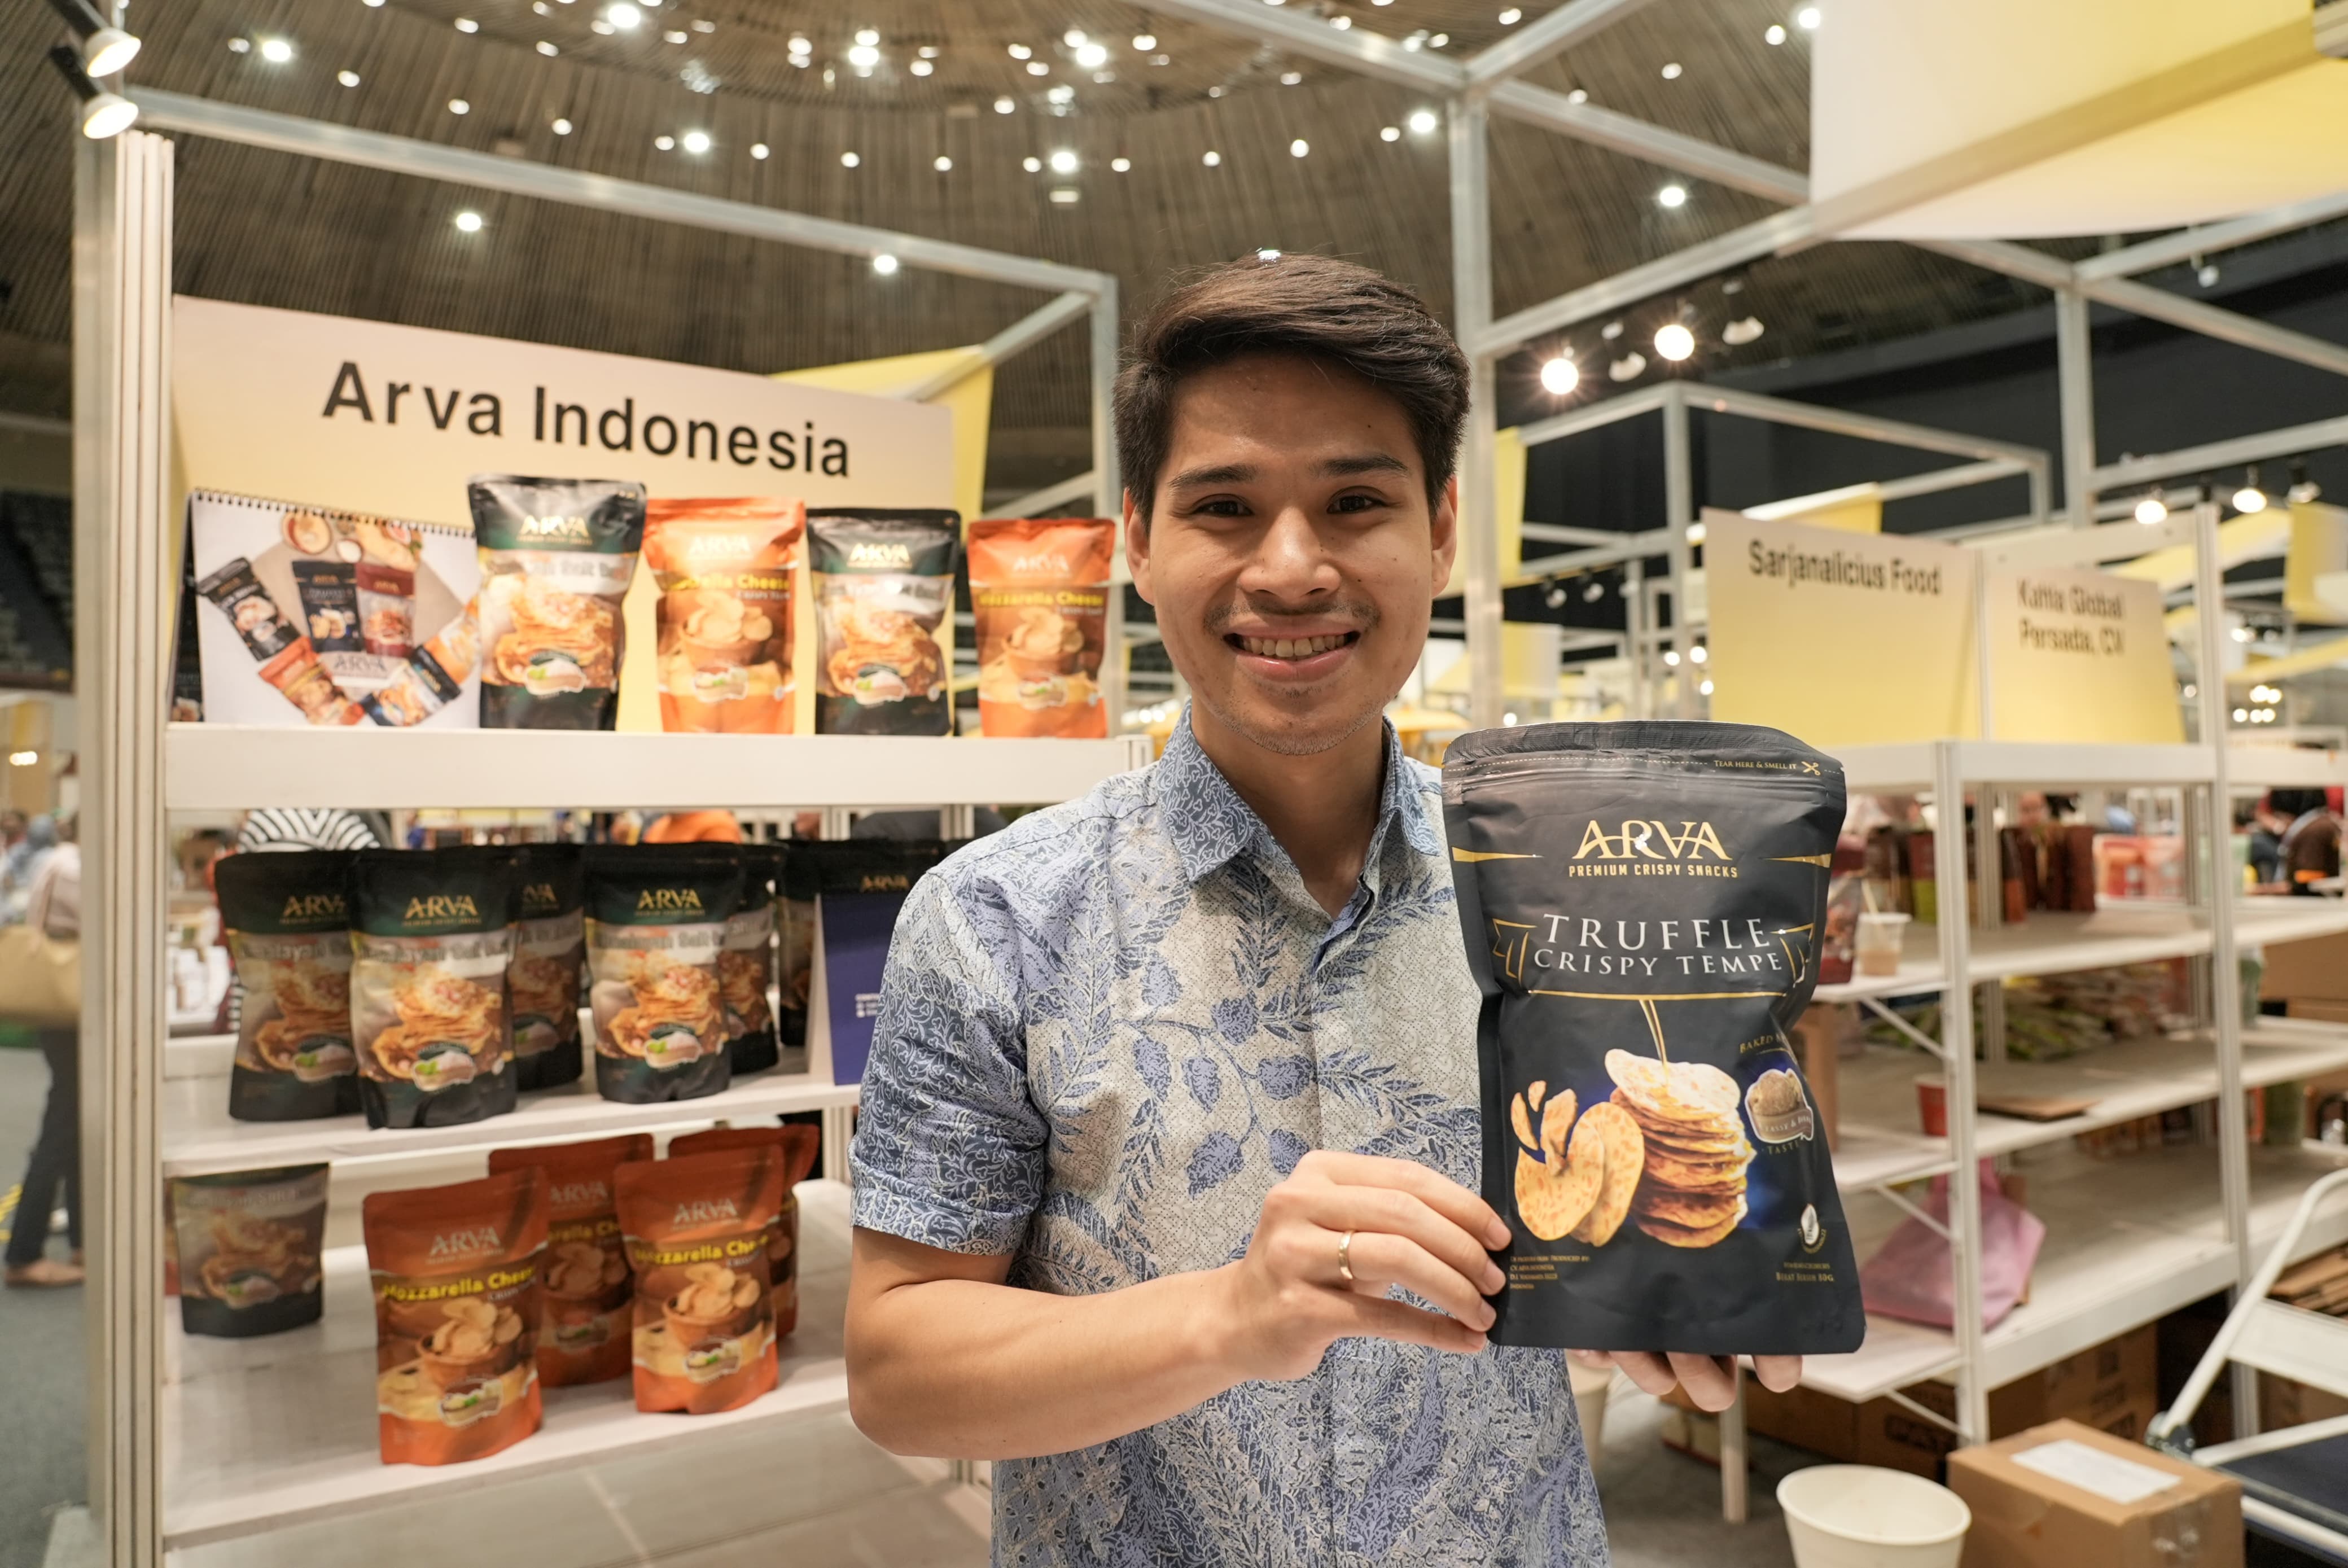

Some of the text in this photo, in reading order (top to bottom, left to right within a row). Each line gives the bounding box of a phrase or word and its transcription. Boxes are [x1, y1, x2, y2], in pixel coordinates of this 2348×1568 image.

[322, 361, 849, 478] Arva Indonesia
[1749, 538, 1942, 595] Sarjanalicius Food
[2069, 584, 2125, 620] Global
[2018, 617, 2096, 656] Persada,
[1571, 820, 1733, 861] ARVA
[1569, 864, 1738, 879] PREMIUM CRISPY SNACKS
[405, 894, 479, 919] ARVA
[637, 888, 703, 909] ARVA
[1543, 913, 1770, 951] TRUFFLE
[1534, 948, 1782, 976] CRISPY TEMPE
[1740, 1035, 1773, 1054] BAKED
[549, 1181, 608, 1203] ARVA
[673, 1197, 738, 1224] ARVA
[429, 1225, 501, 1256] ARVA
[383, 1276, 485, 1301] Mozzarella
